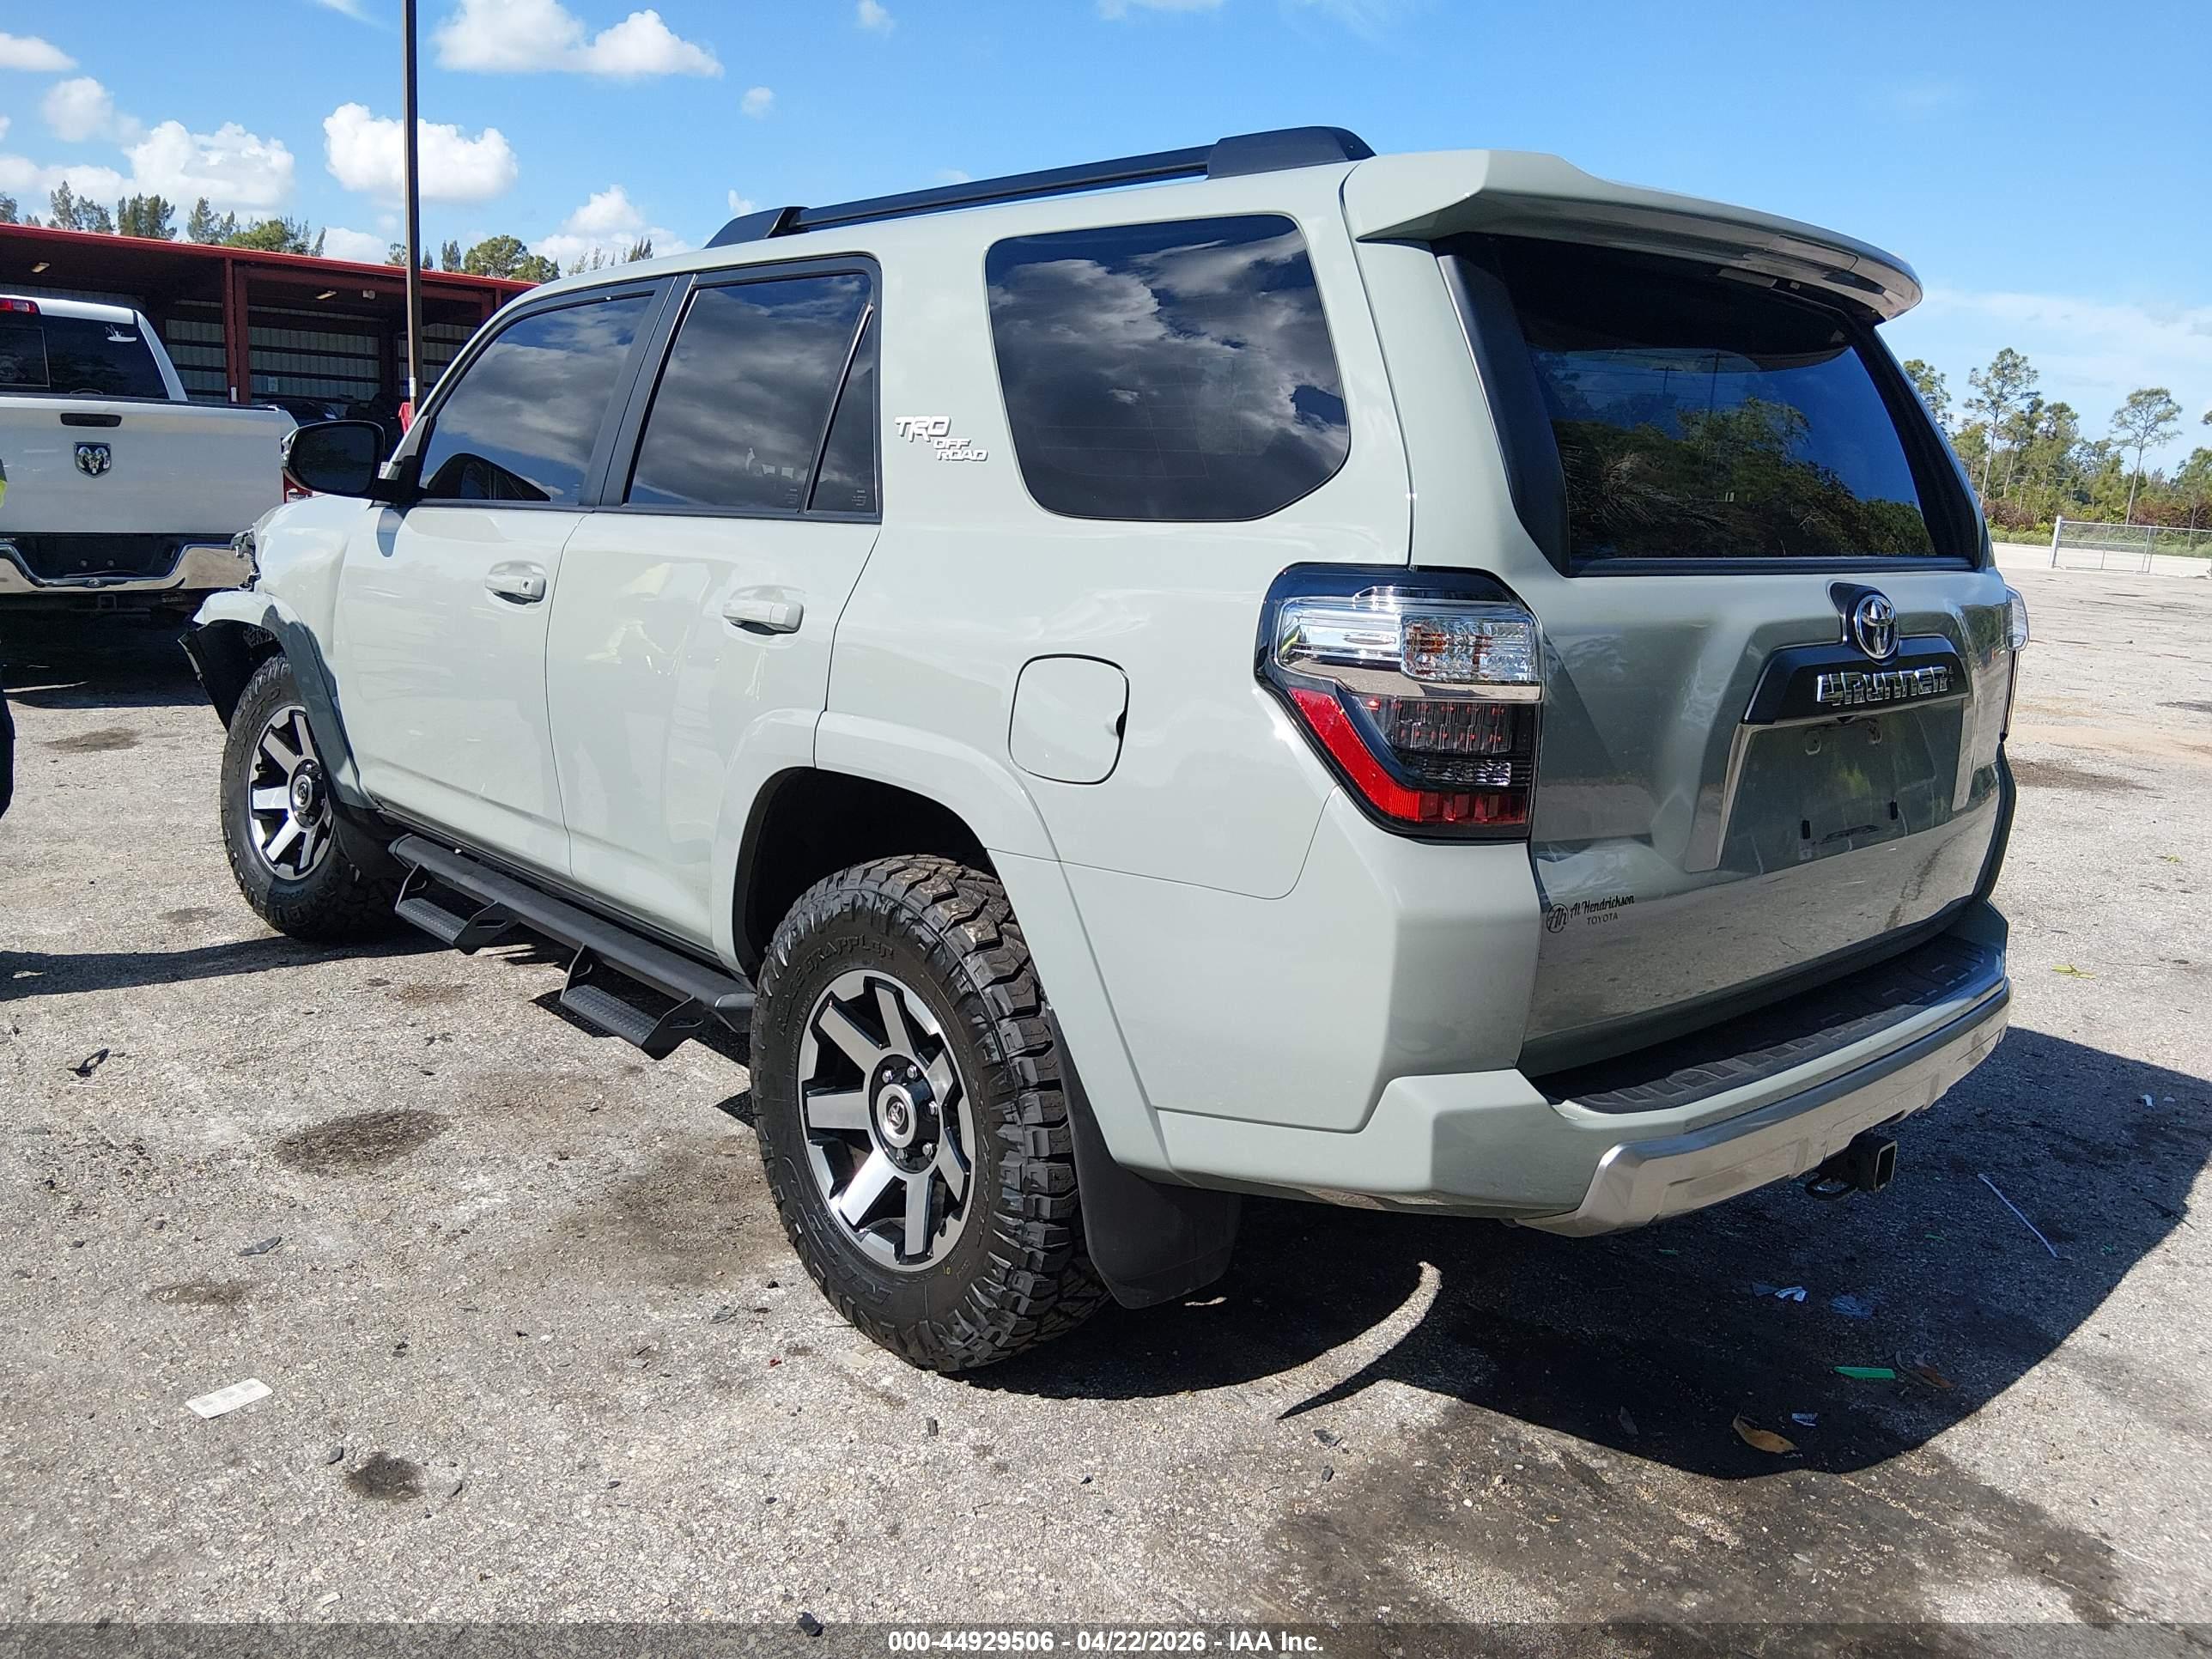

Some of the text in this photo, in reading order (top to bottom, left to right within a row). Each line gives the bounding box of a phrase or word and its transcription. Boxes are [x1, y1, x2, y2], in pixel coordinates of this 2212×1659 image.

[894, 416, 951, 442] TRD
[933, 437, 971, 450] OFF
[935, 448, 988, 462] ROAD
[1582, 895, 1635, 915] Hendrickson
[1587, 912, 1619, 926] TOYOTA
